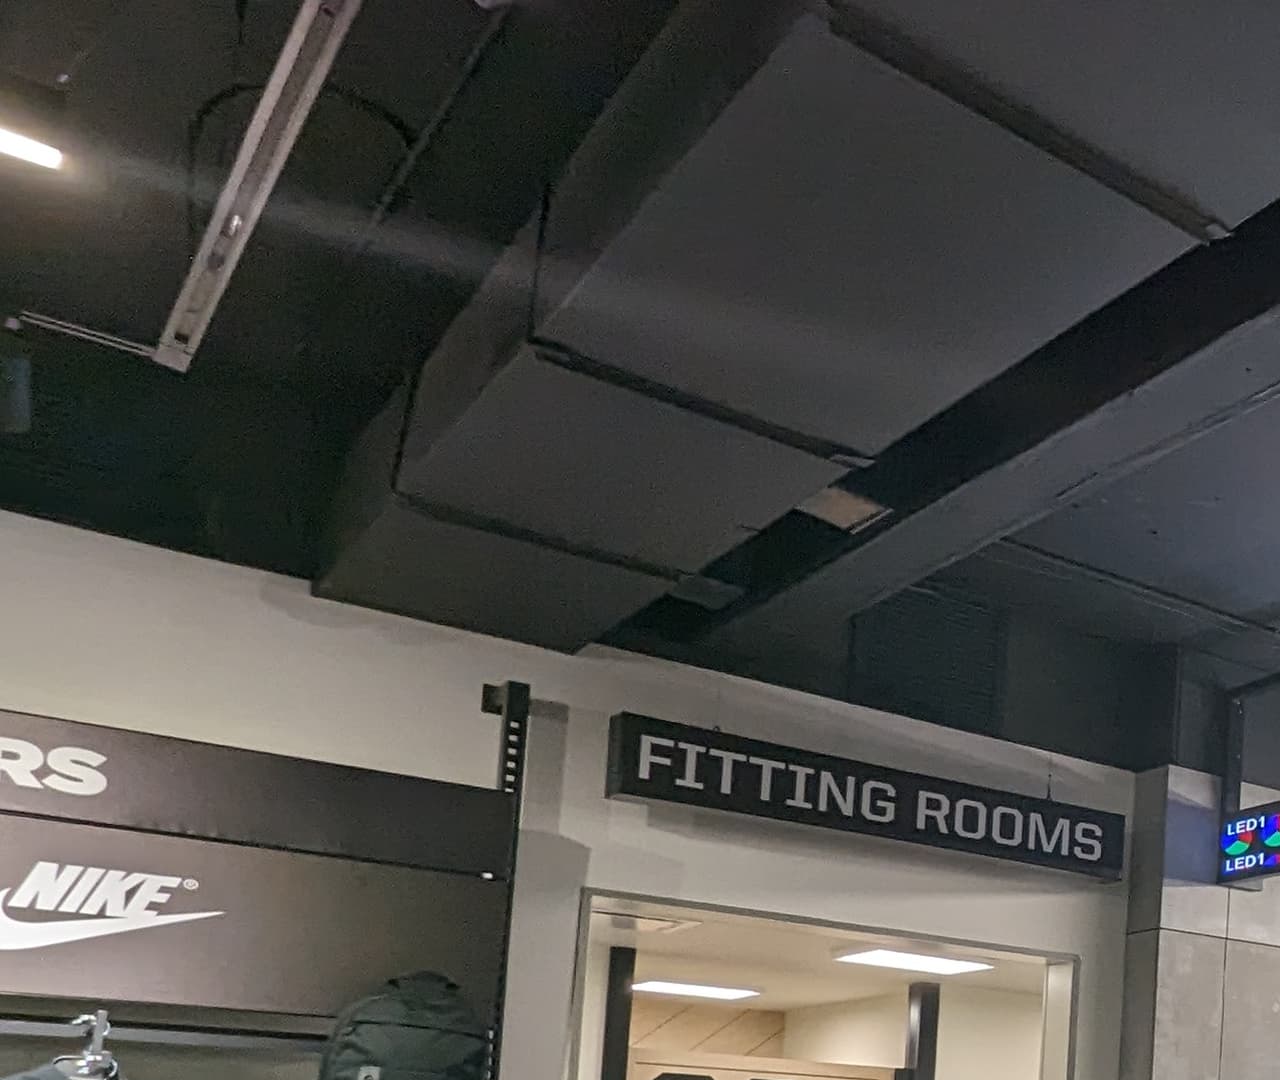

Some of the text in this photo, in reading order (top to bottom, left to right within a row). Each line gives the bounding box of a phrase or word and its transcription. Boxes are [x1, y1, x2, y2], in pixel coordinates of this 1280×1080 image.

[637, 734, 1104, 862] FITTING ROOMS
[1227, 815, 1266, 836] LED1
[1225, 852, 1265, 873] LED1
[7, 861, 182, 919] NIKE
